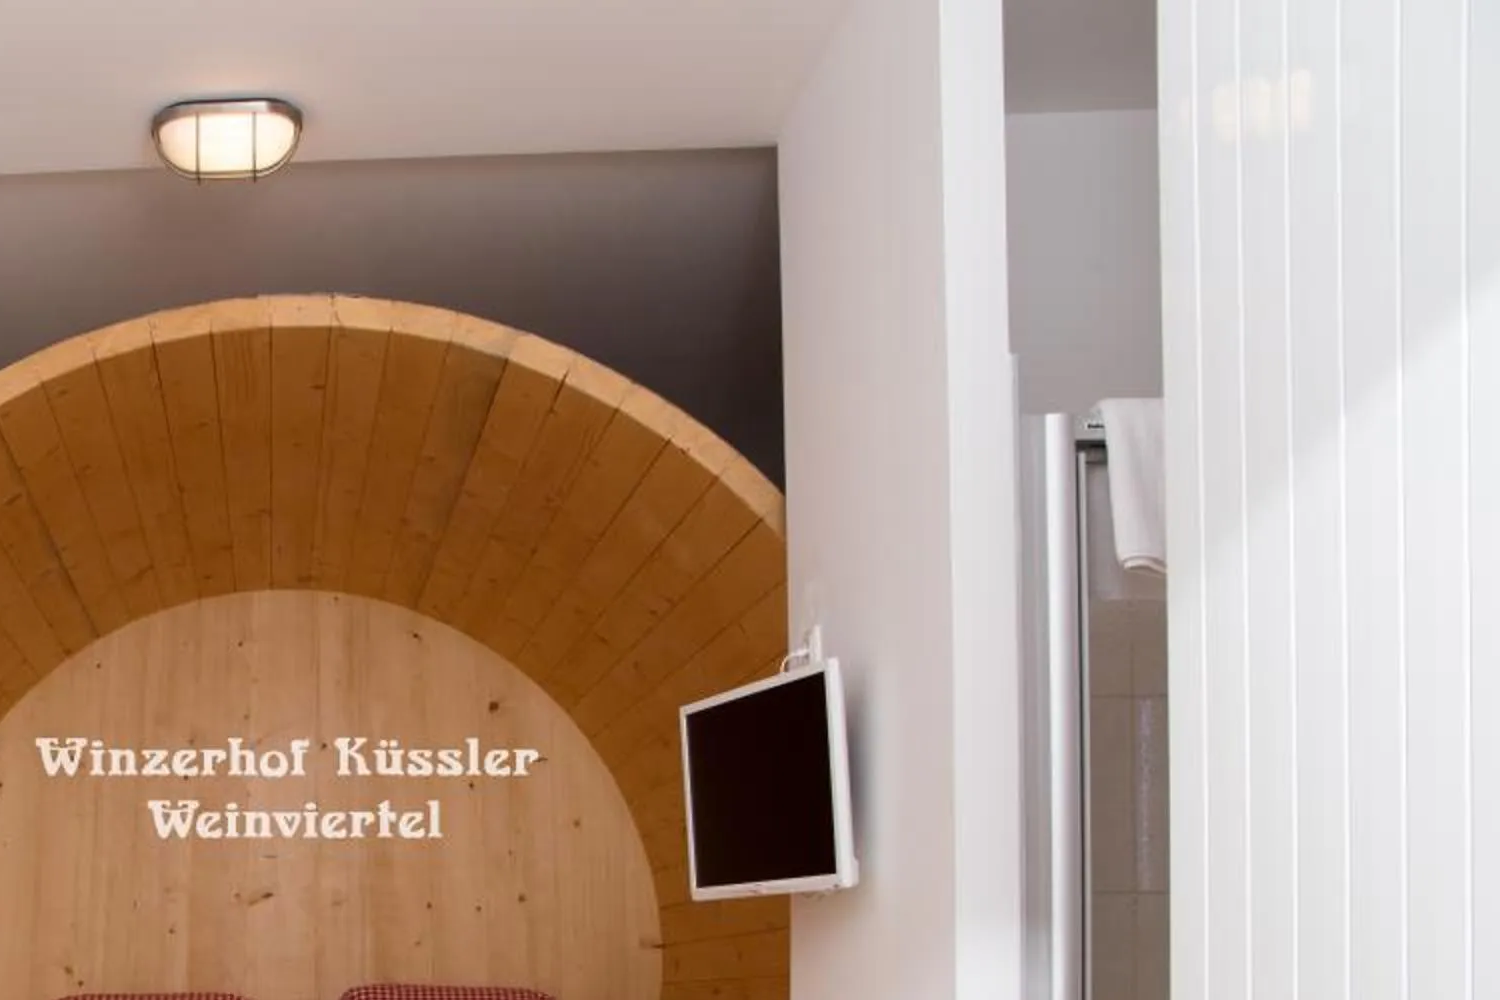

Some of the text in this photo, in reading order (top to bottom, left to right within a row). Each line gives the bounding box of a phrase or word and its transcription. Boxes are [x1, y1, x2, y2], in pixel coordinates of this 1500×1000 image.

[36, 737, 539, 777] Winzerhof Küssler
[148, 800, 441, 839] Weinviertel
